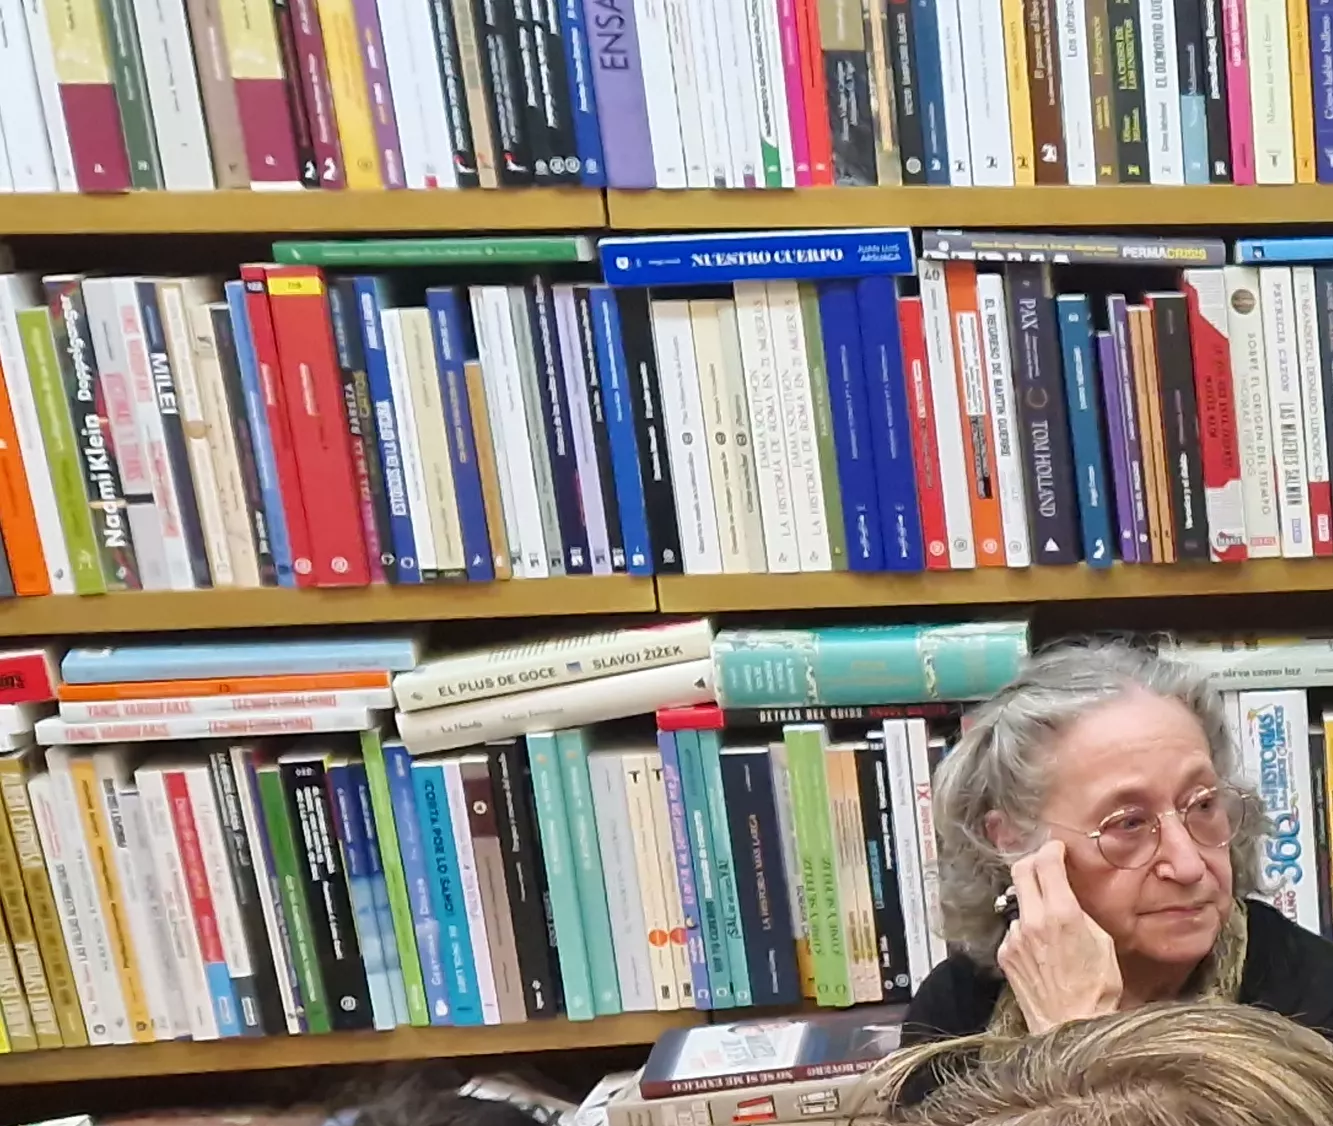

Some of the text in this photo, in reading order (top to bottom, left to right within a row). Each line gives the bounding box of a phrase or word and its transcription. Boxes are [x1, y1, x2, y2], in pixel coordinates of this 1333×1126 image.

[1150, 23, 1167, 74] DEMONIO
[1155, 76, 1168, 88] EL
[690, 247, 843, 267] NUESTRO CUERPO
[1019, 297, 1038, 329] PAX
[149, 350, 178, 416] MILEI
[80, 413, 108, 473] Klein
[1030, 420, 1057, 518] TOM HOLLAND
[90, 471, 127, 548] Naomi
[437, 642, 683, 697] EL PLUS DE GOCE SLAVOJ ŽIŽEK
[671, 1068, 792, 1093] NO SÉ SI ME EXPLICO
